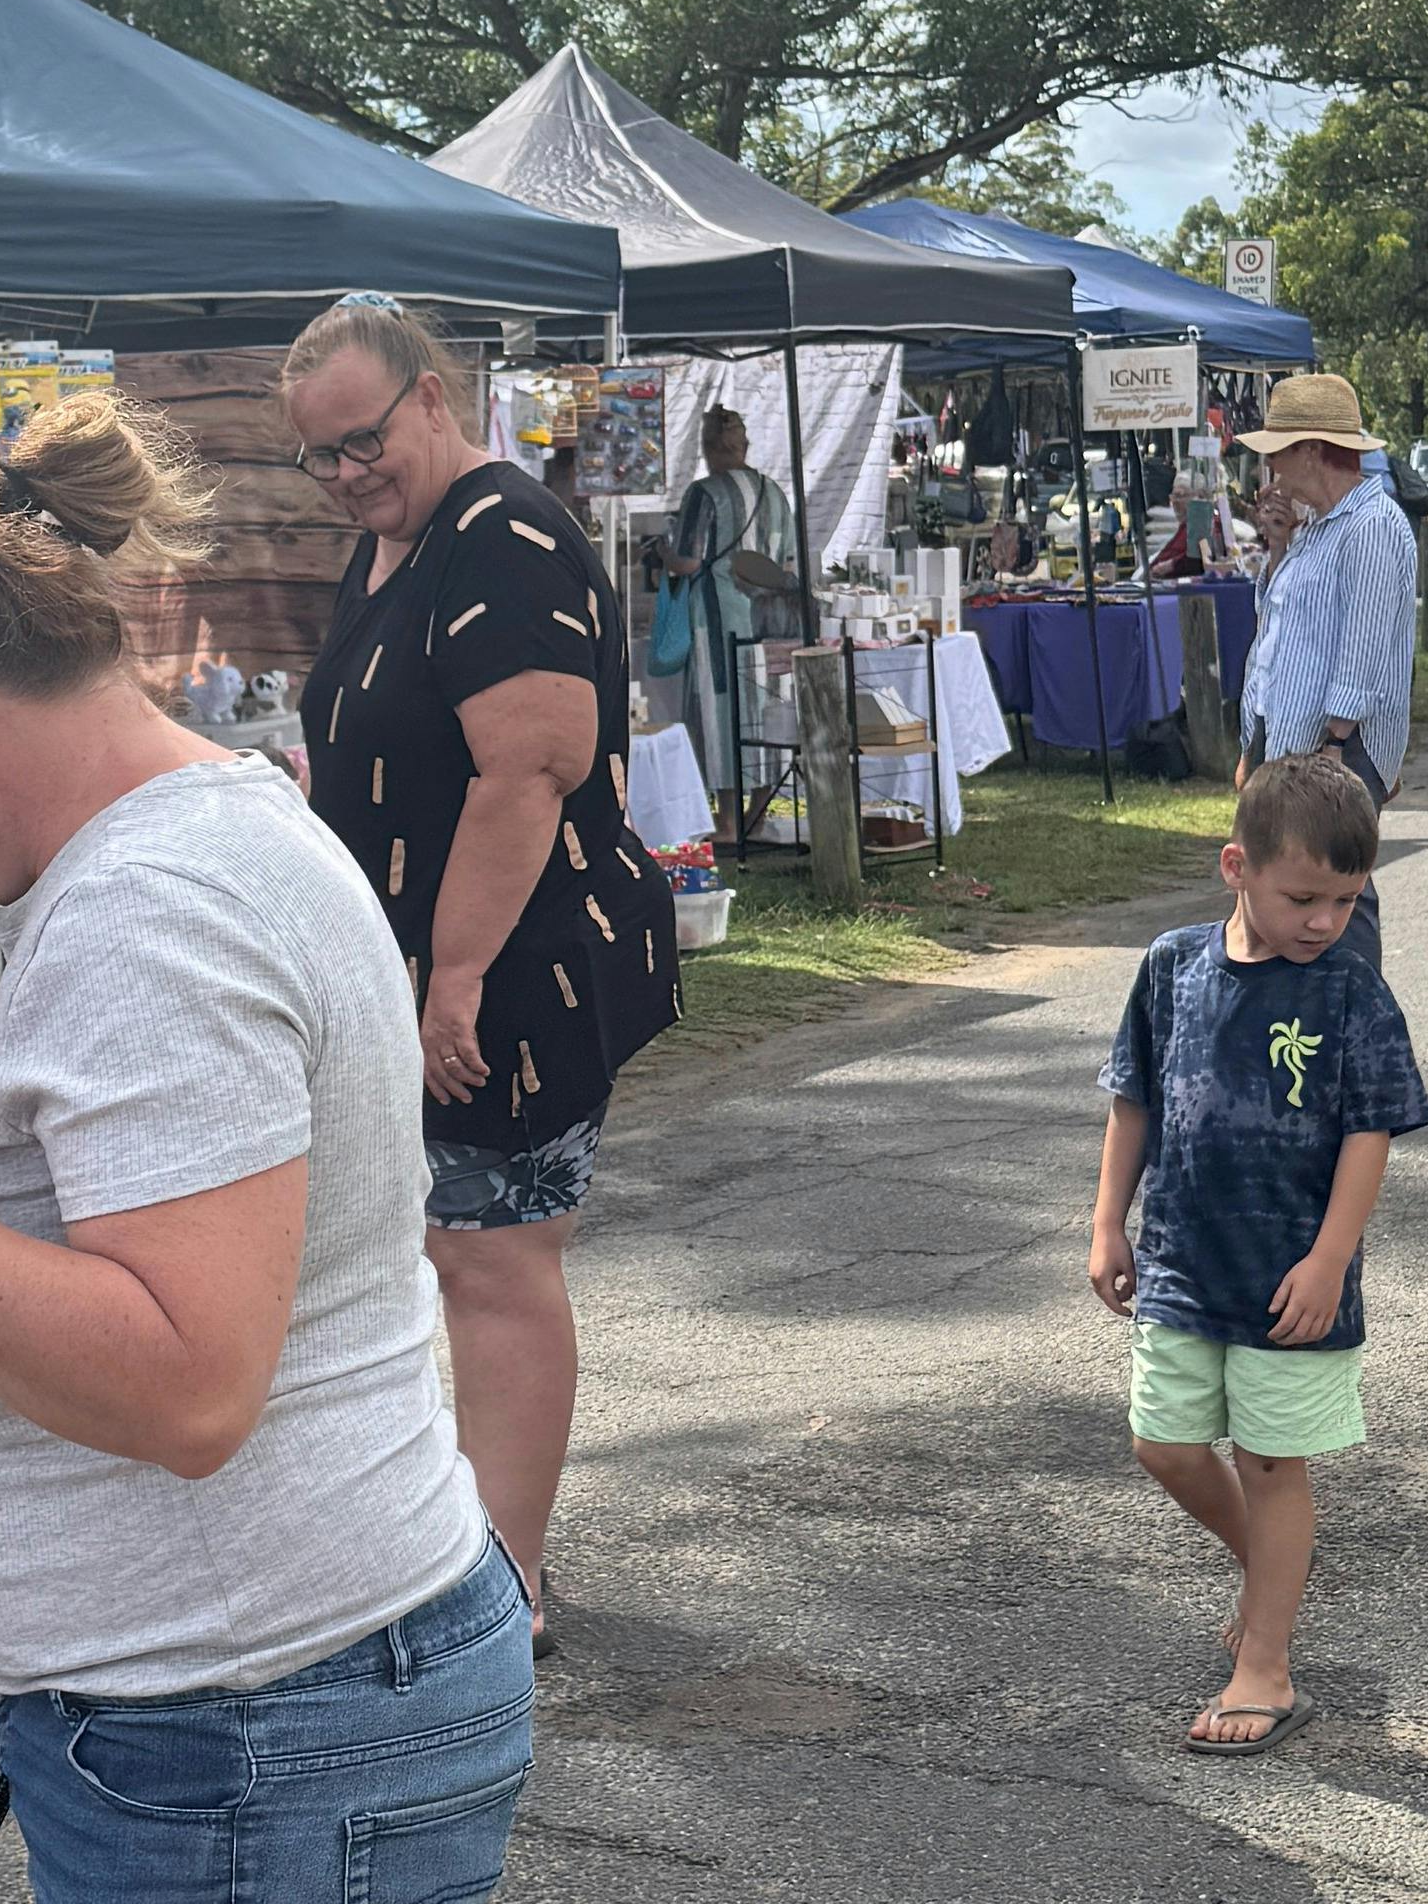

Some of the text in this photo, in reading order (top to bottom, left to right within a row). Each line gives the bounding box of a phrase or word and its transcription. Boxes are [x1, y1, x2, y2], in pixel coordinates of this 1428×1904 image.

[1243, 252, 1256, 265] 10
[1232, 276, 1266, 285] SHARED
[1110, 368, 1173, 387] IGNITE
